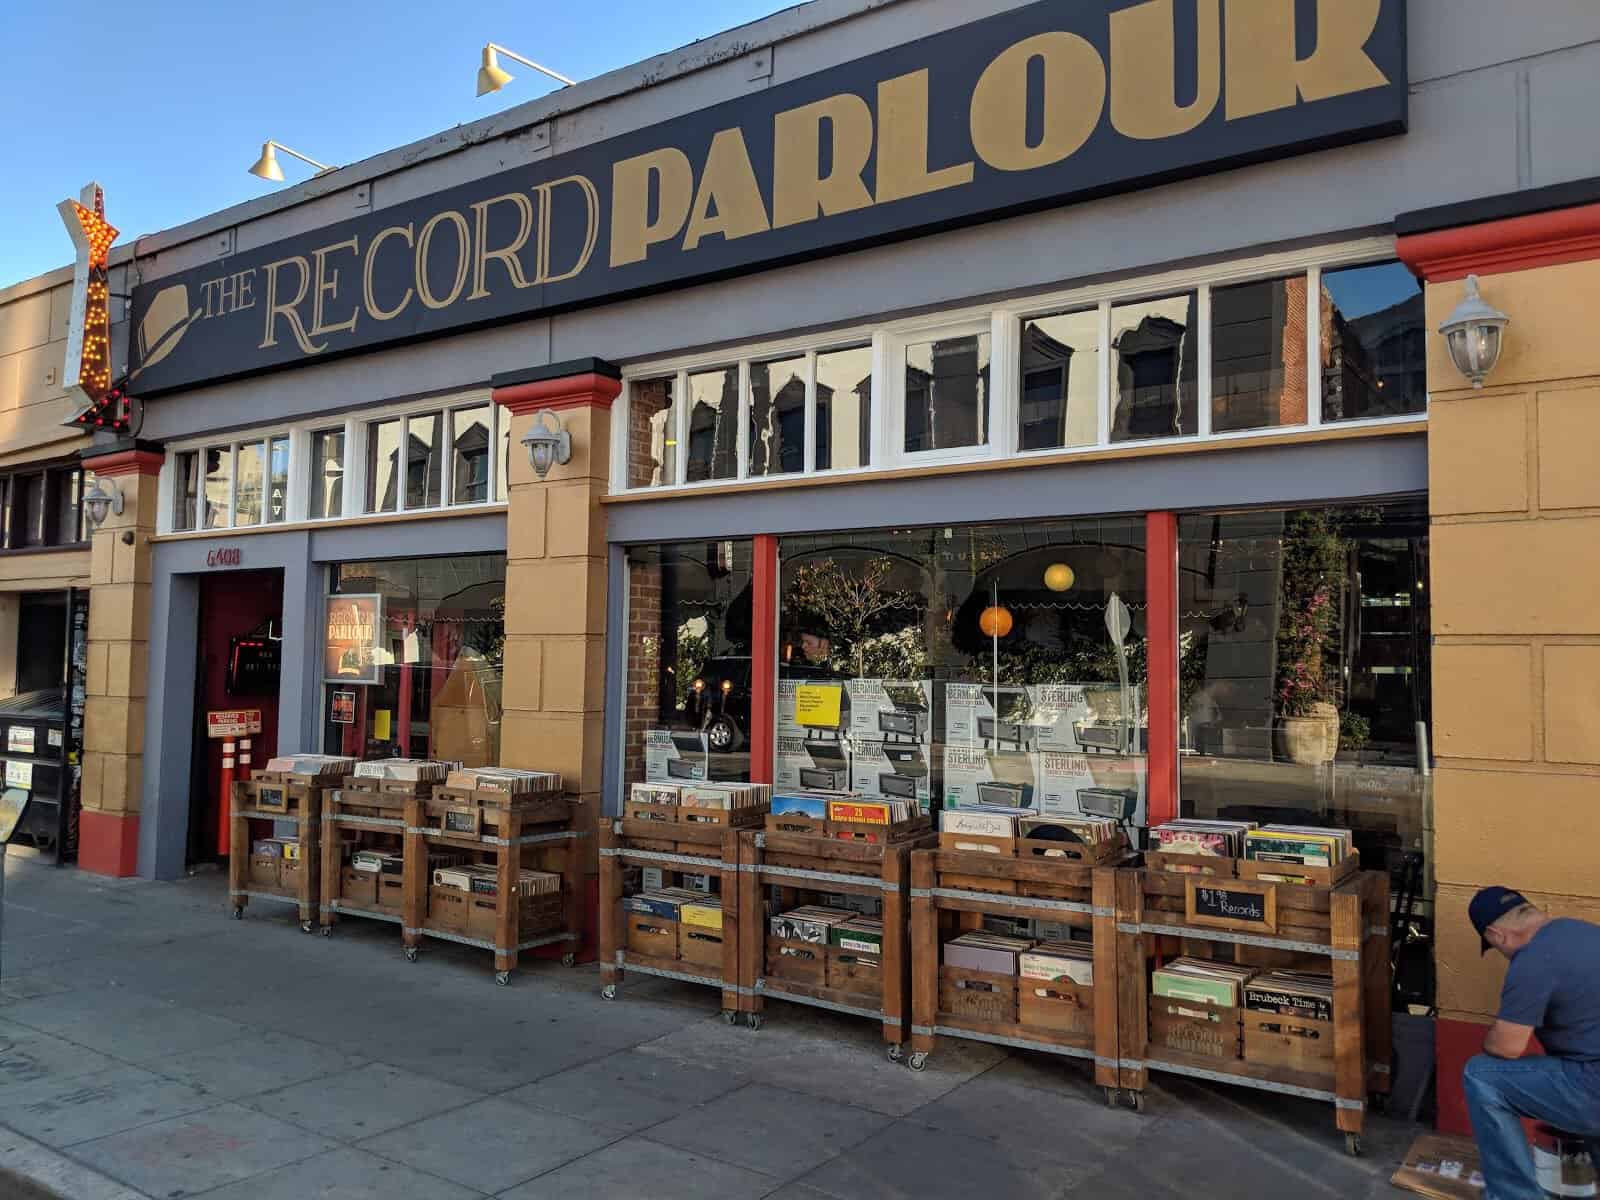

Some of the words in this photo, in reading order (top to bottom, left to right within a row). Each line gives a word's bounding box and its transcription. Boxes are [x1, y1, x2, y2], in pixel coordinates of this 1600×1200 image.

[199, 267, 257, 319] THE
[258, 174, 600, 355] RECORD
[609, 0, 1391, 268] PARLOUR
[207, 547, 241, 567] 6408
[1040, 689, 1084, 703] STERLING
[948, 753, 986, 765] STERLING
[1044, 758, 1087, 772] STERLING
[1249, 991, 1290, 1005] Brubeck
[1293, 997, 1316, 1009] Time
